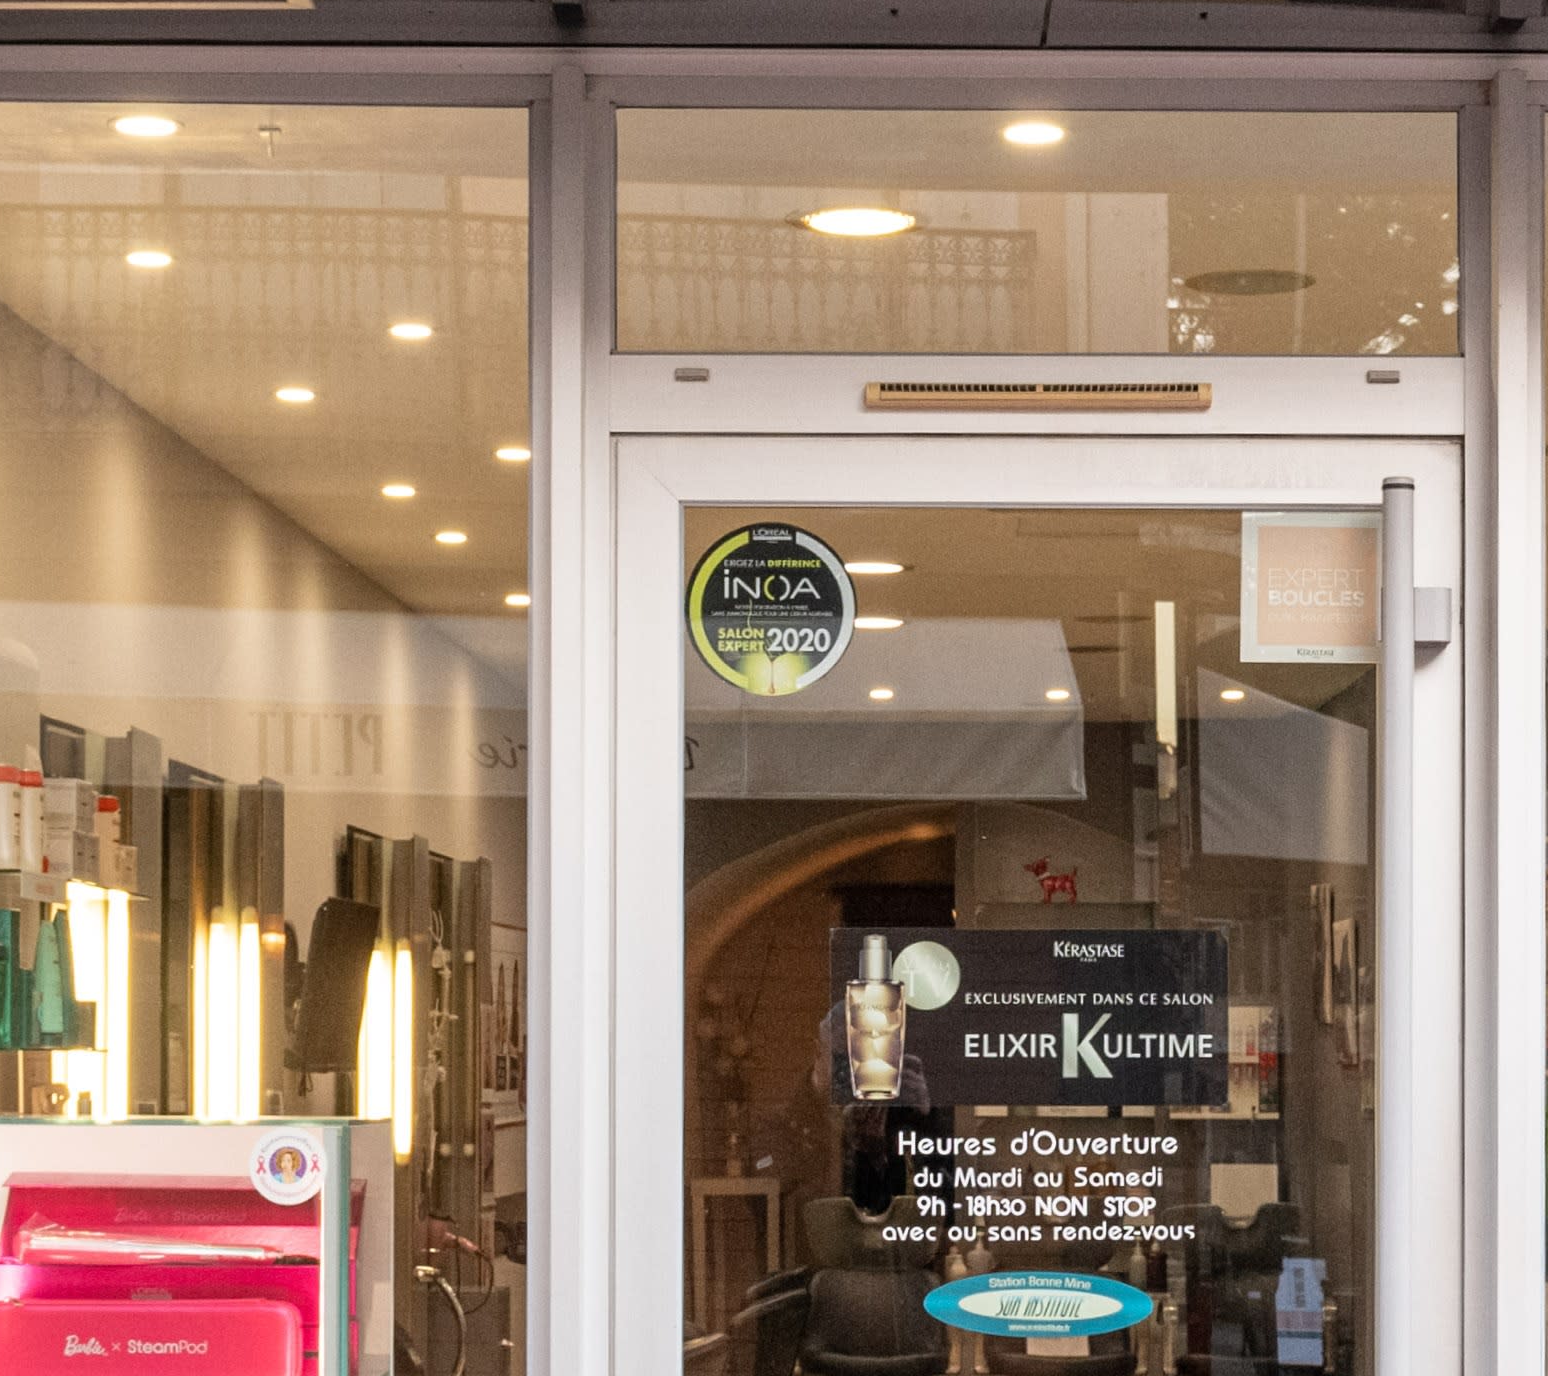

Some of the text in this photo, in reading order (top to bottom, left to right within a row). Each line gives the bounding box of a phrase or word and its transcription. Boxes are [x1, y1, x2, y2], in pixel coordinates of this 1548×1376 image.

[1268, 568, 1365, 589] EXPERT
[1268, 590, 1365, 607] BOUCLES
[718, 628, 831, 652] SALON 2020
[718, 640, 764, 651] EXPERT
[1054, 941, 1124, 958] KÉRASTASE
[964, 992, 1213, 1006] EXCLUSIVEMENT DANS CE SALON
[964, 1033, 1057, 1058] ELIXIR
[898, 1127, 1178, 1156] Heures d'Ouverture
[913, 1165, 1163, 1188] du Mardi au Samedi
[916, 1195, 946, 1217] 9h
[1035, 1195, 1088, 1217] NON
[1103, 1196, 1157, 1218] STOP
[882, 1220, 1196, 1242] avec ou sans rendez-vous
[989, 1277, 1091, 1289] Station Bonne Mine
[64, 1335, 108, 1356] Barbie
[127, 1340, 208, 1354] SteamPod
